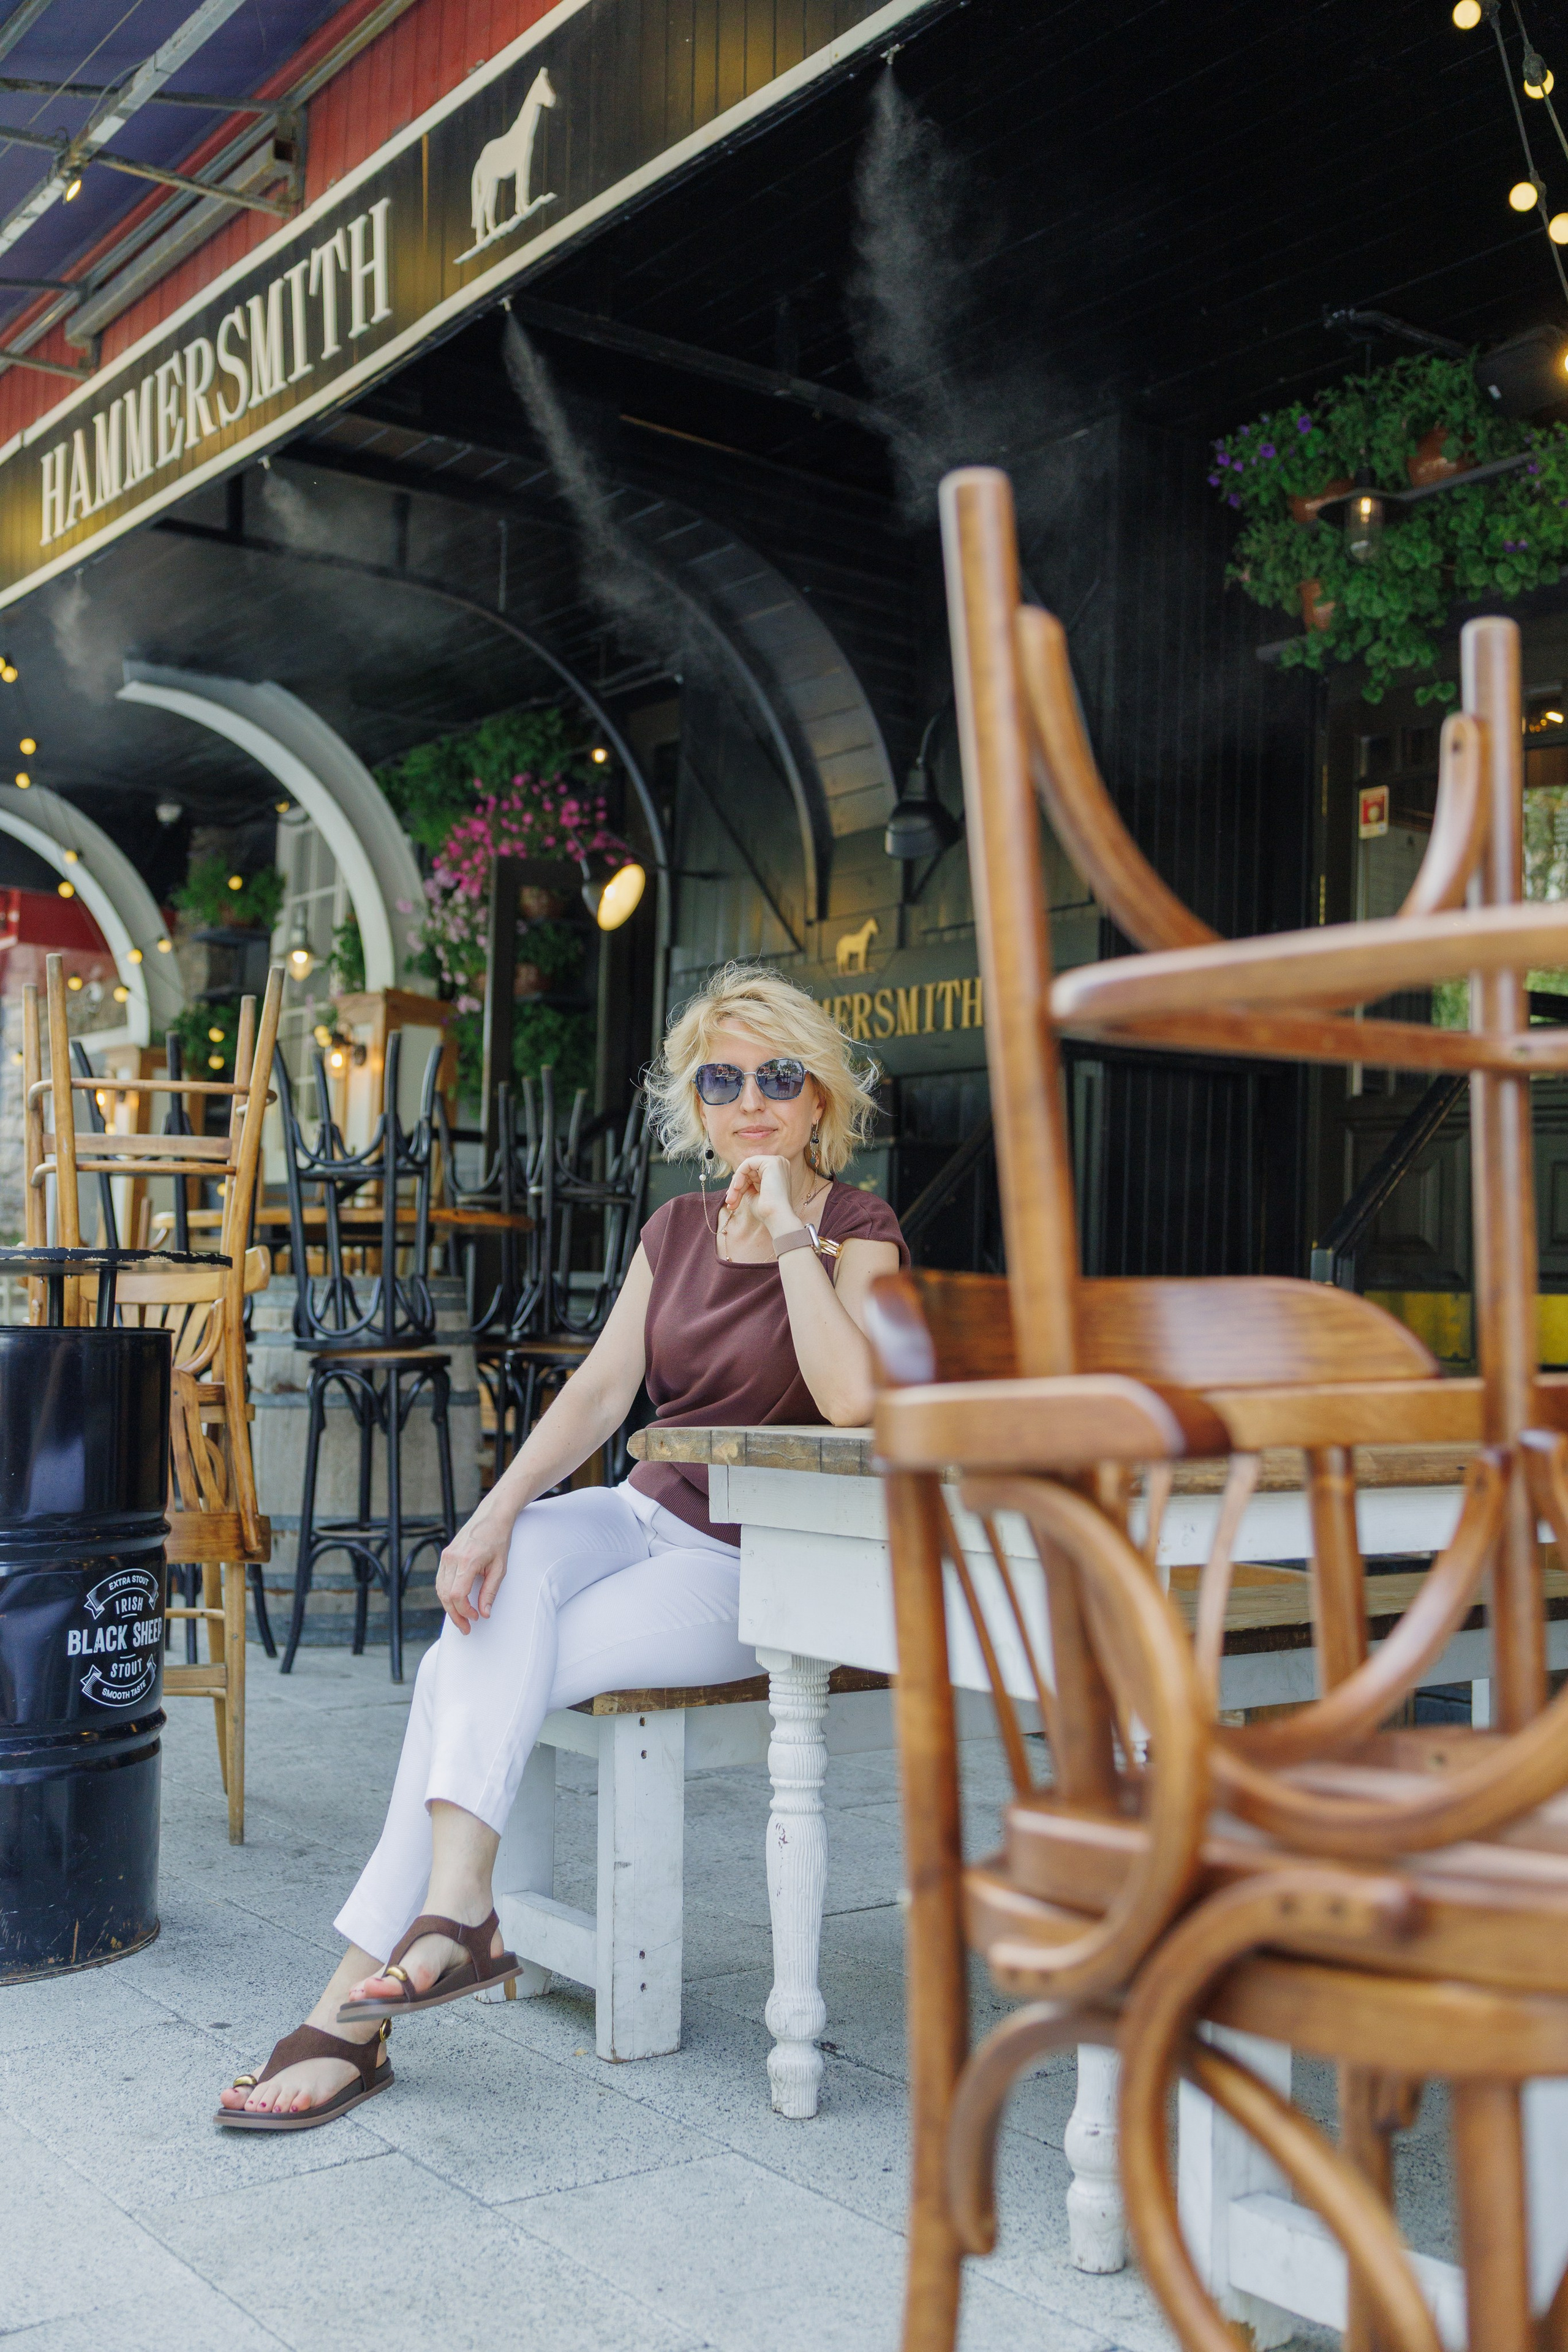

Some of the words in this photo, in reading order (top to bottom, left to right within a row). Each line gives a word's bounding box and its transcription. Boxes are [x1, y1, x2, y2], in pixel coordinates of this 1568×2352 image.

[40, 197, 393, 546] HAMMERSMITH
[108, 1576, 131, 1591] EXTRA
[132, 1575, 149, 1586] STOUT
[115, 1596, 144, 1615] IRISH
[67, 1624, 128, 1656] BLACK
[132, 1616, 162, 1648] SHEEP
[110, 1658, 143, 1678] STOUT
[102, 1687, 130, 1700] SMOOTH
[130, 1679, 146, 1697] TASTE
